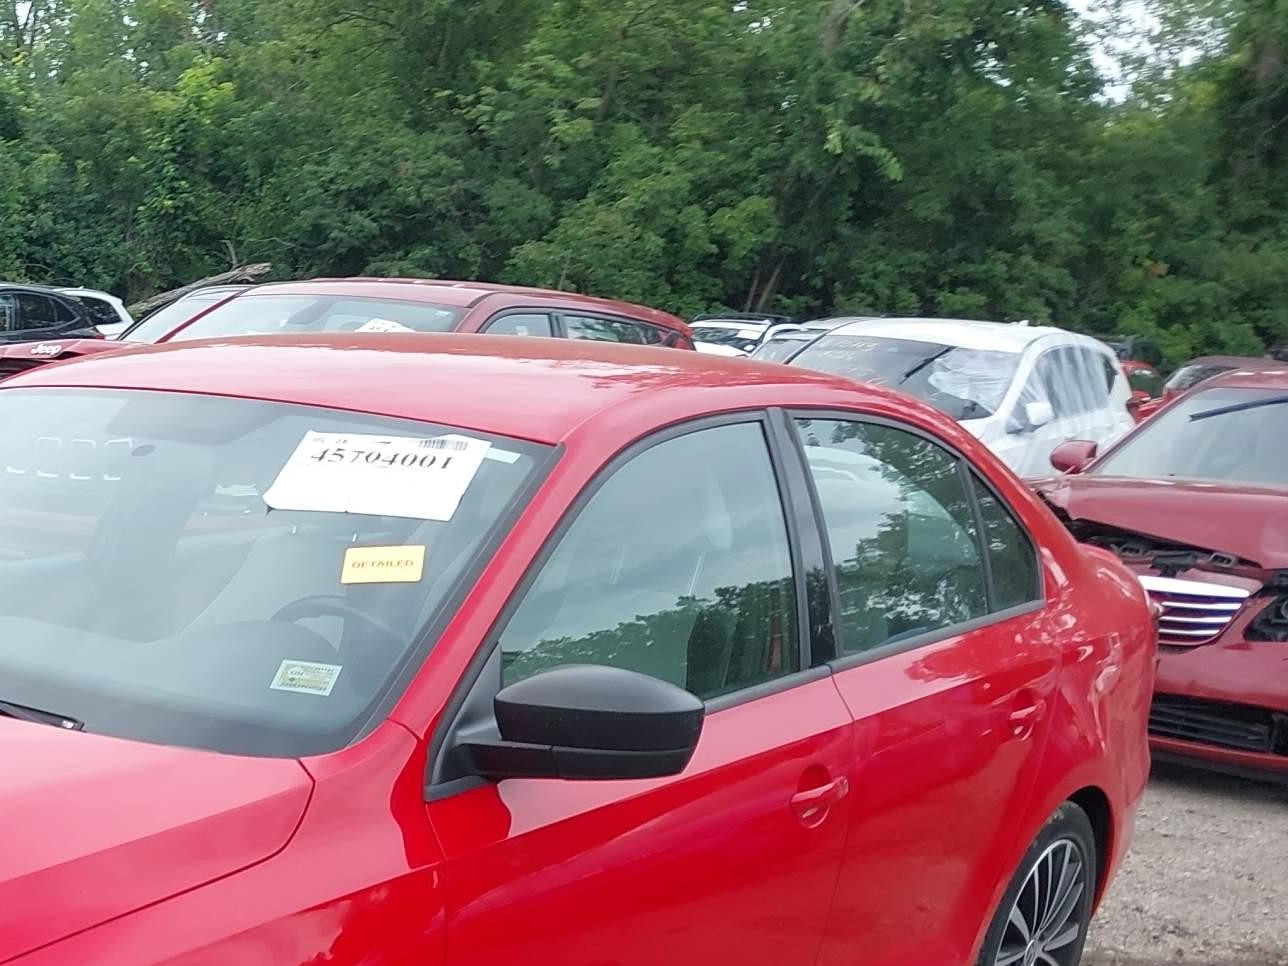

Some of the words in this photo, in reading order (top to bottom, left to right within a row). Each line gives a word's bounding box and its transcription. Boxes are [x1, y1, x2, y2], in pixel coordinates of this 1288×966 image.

[31, 343, 62, 355] Jeep
[311, 448, 453, 469] 45704001
[351, 559, 414, 569] DETAILED
